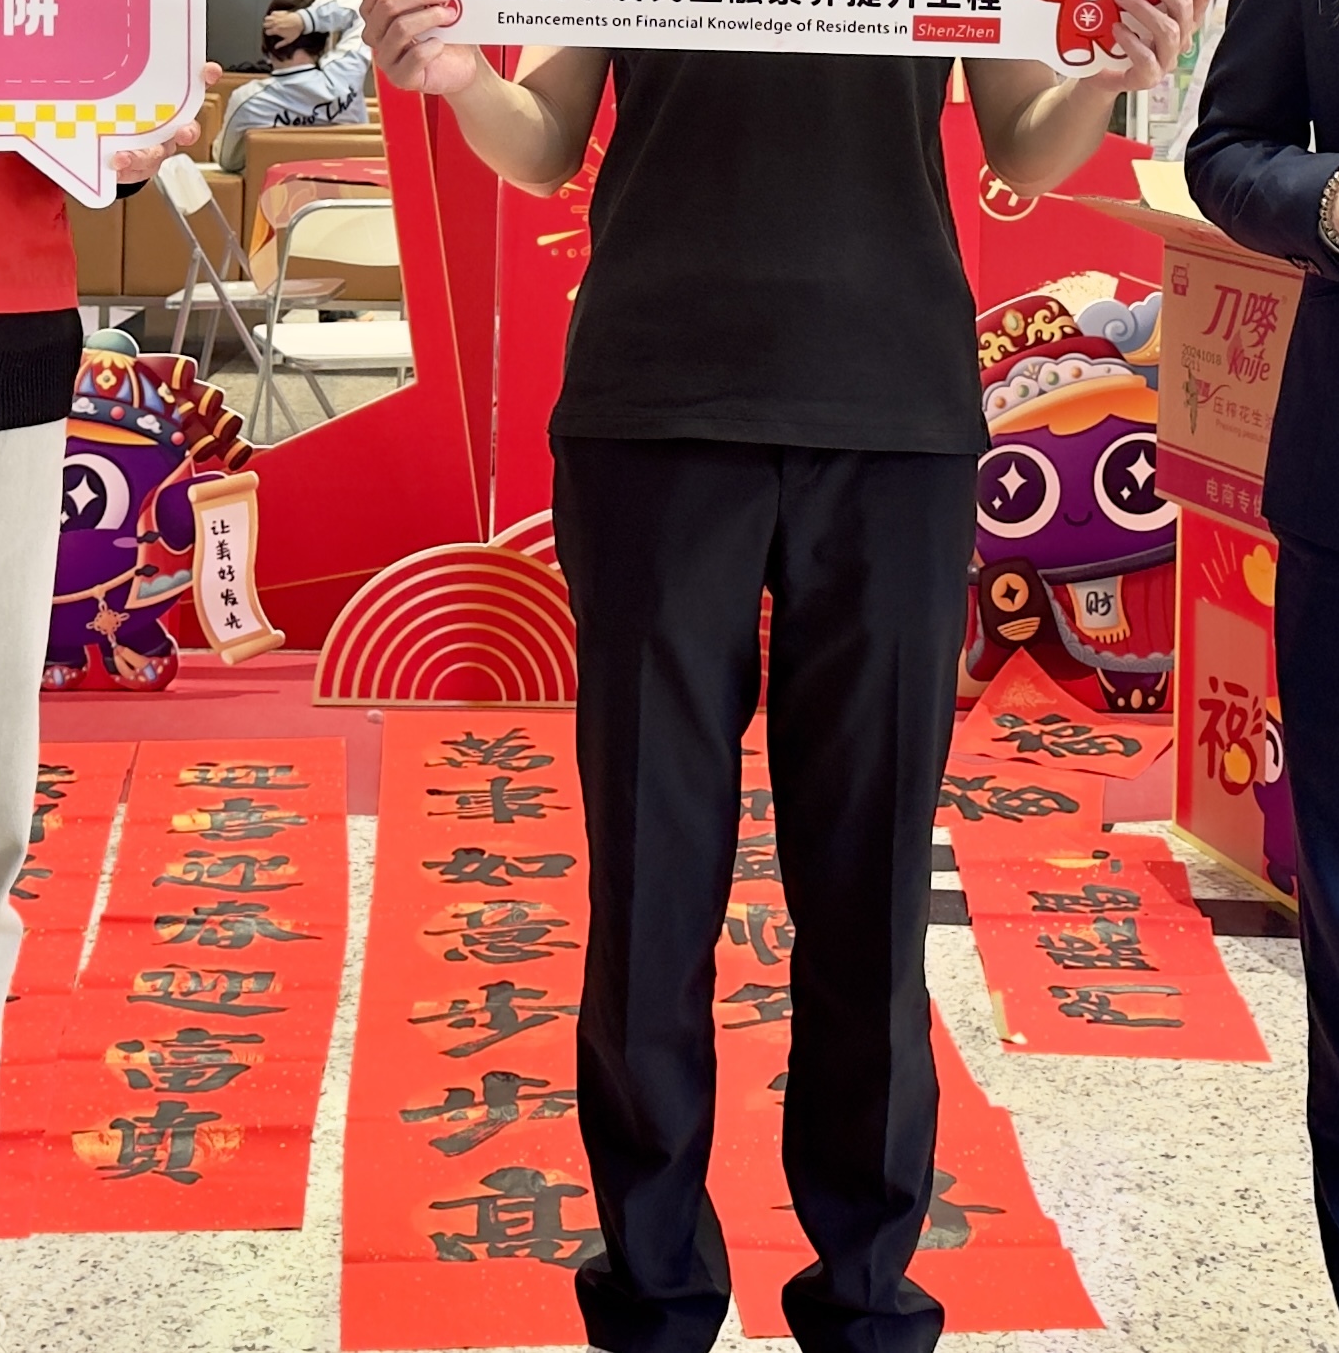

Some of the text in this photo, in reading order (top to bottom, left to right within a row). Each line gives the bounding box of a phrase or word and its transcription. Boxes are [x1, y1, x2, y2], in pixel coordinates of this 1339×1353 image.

[497, 12, 995, 40] Enhancements on Financial Knowledge of Residents in ShenZhen
[1227, 347, 1271, 384] Knife
[210, 518, 243, 631] 让美好发光
